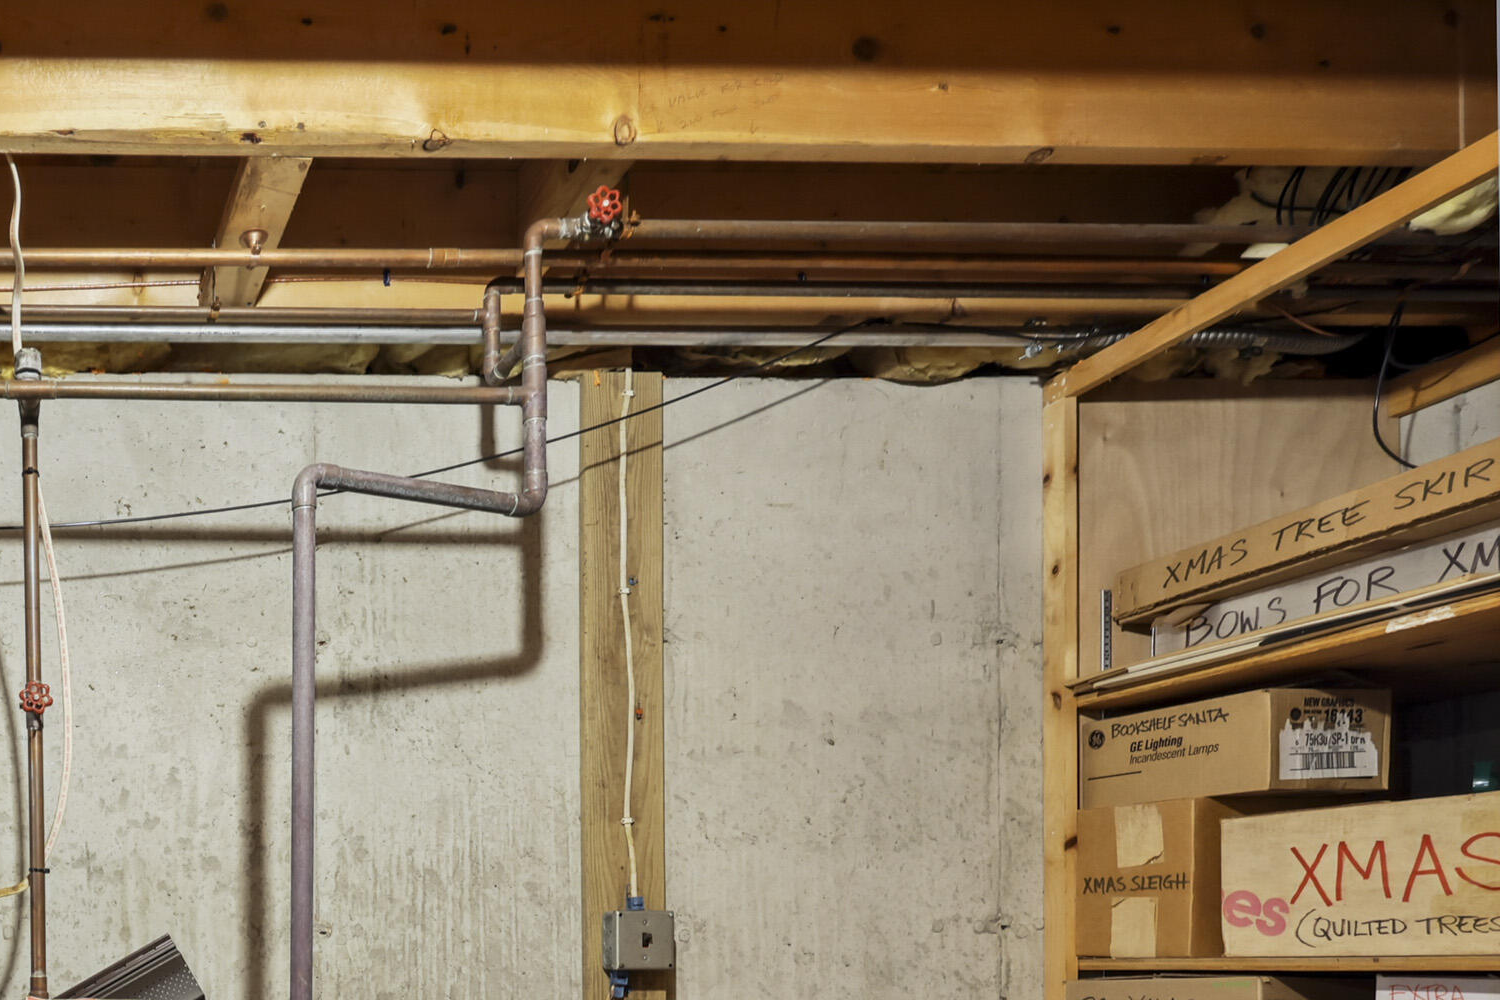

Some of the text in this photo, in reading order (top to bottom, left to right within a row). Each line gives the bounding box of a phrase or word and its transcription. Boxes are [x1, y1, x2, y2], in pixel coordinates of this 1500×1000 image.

[1163, 457, 1496, 589] XMAS TREE SKIR
[1313, 566, 1400, 614] FOR
[1111, 707, 1230, 740] BOOKSHELF SANTA
[1129, 743, 1220, 766] Incandescent Lamps
[1130, 735, 1184, 753] GE Lighting
[1082, 871, 1190, 895] XMAS SLEIGH
[1289, 831, 1500, 907] XMAS
[1295, 907, 1408, 948] (QUILTED
